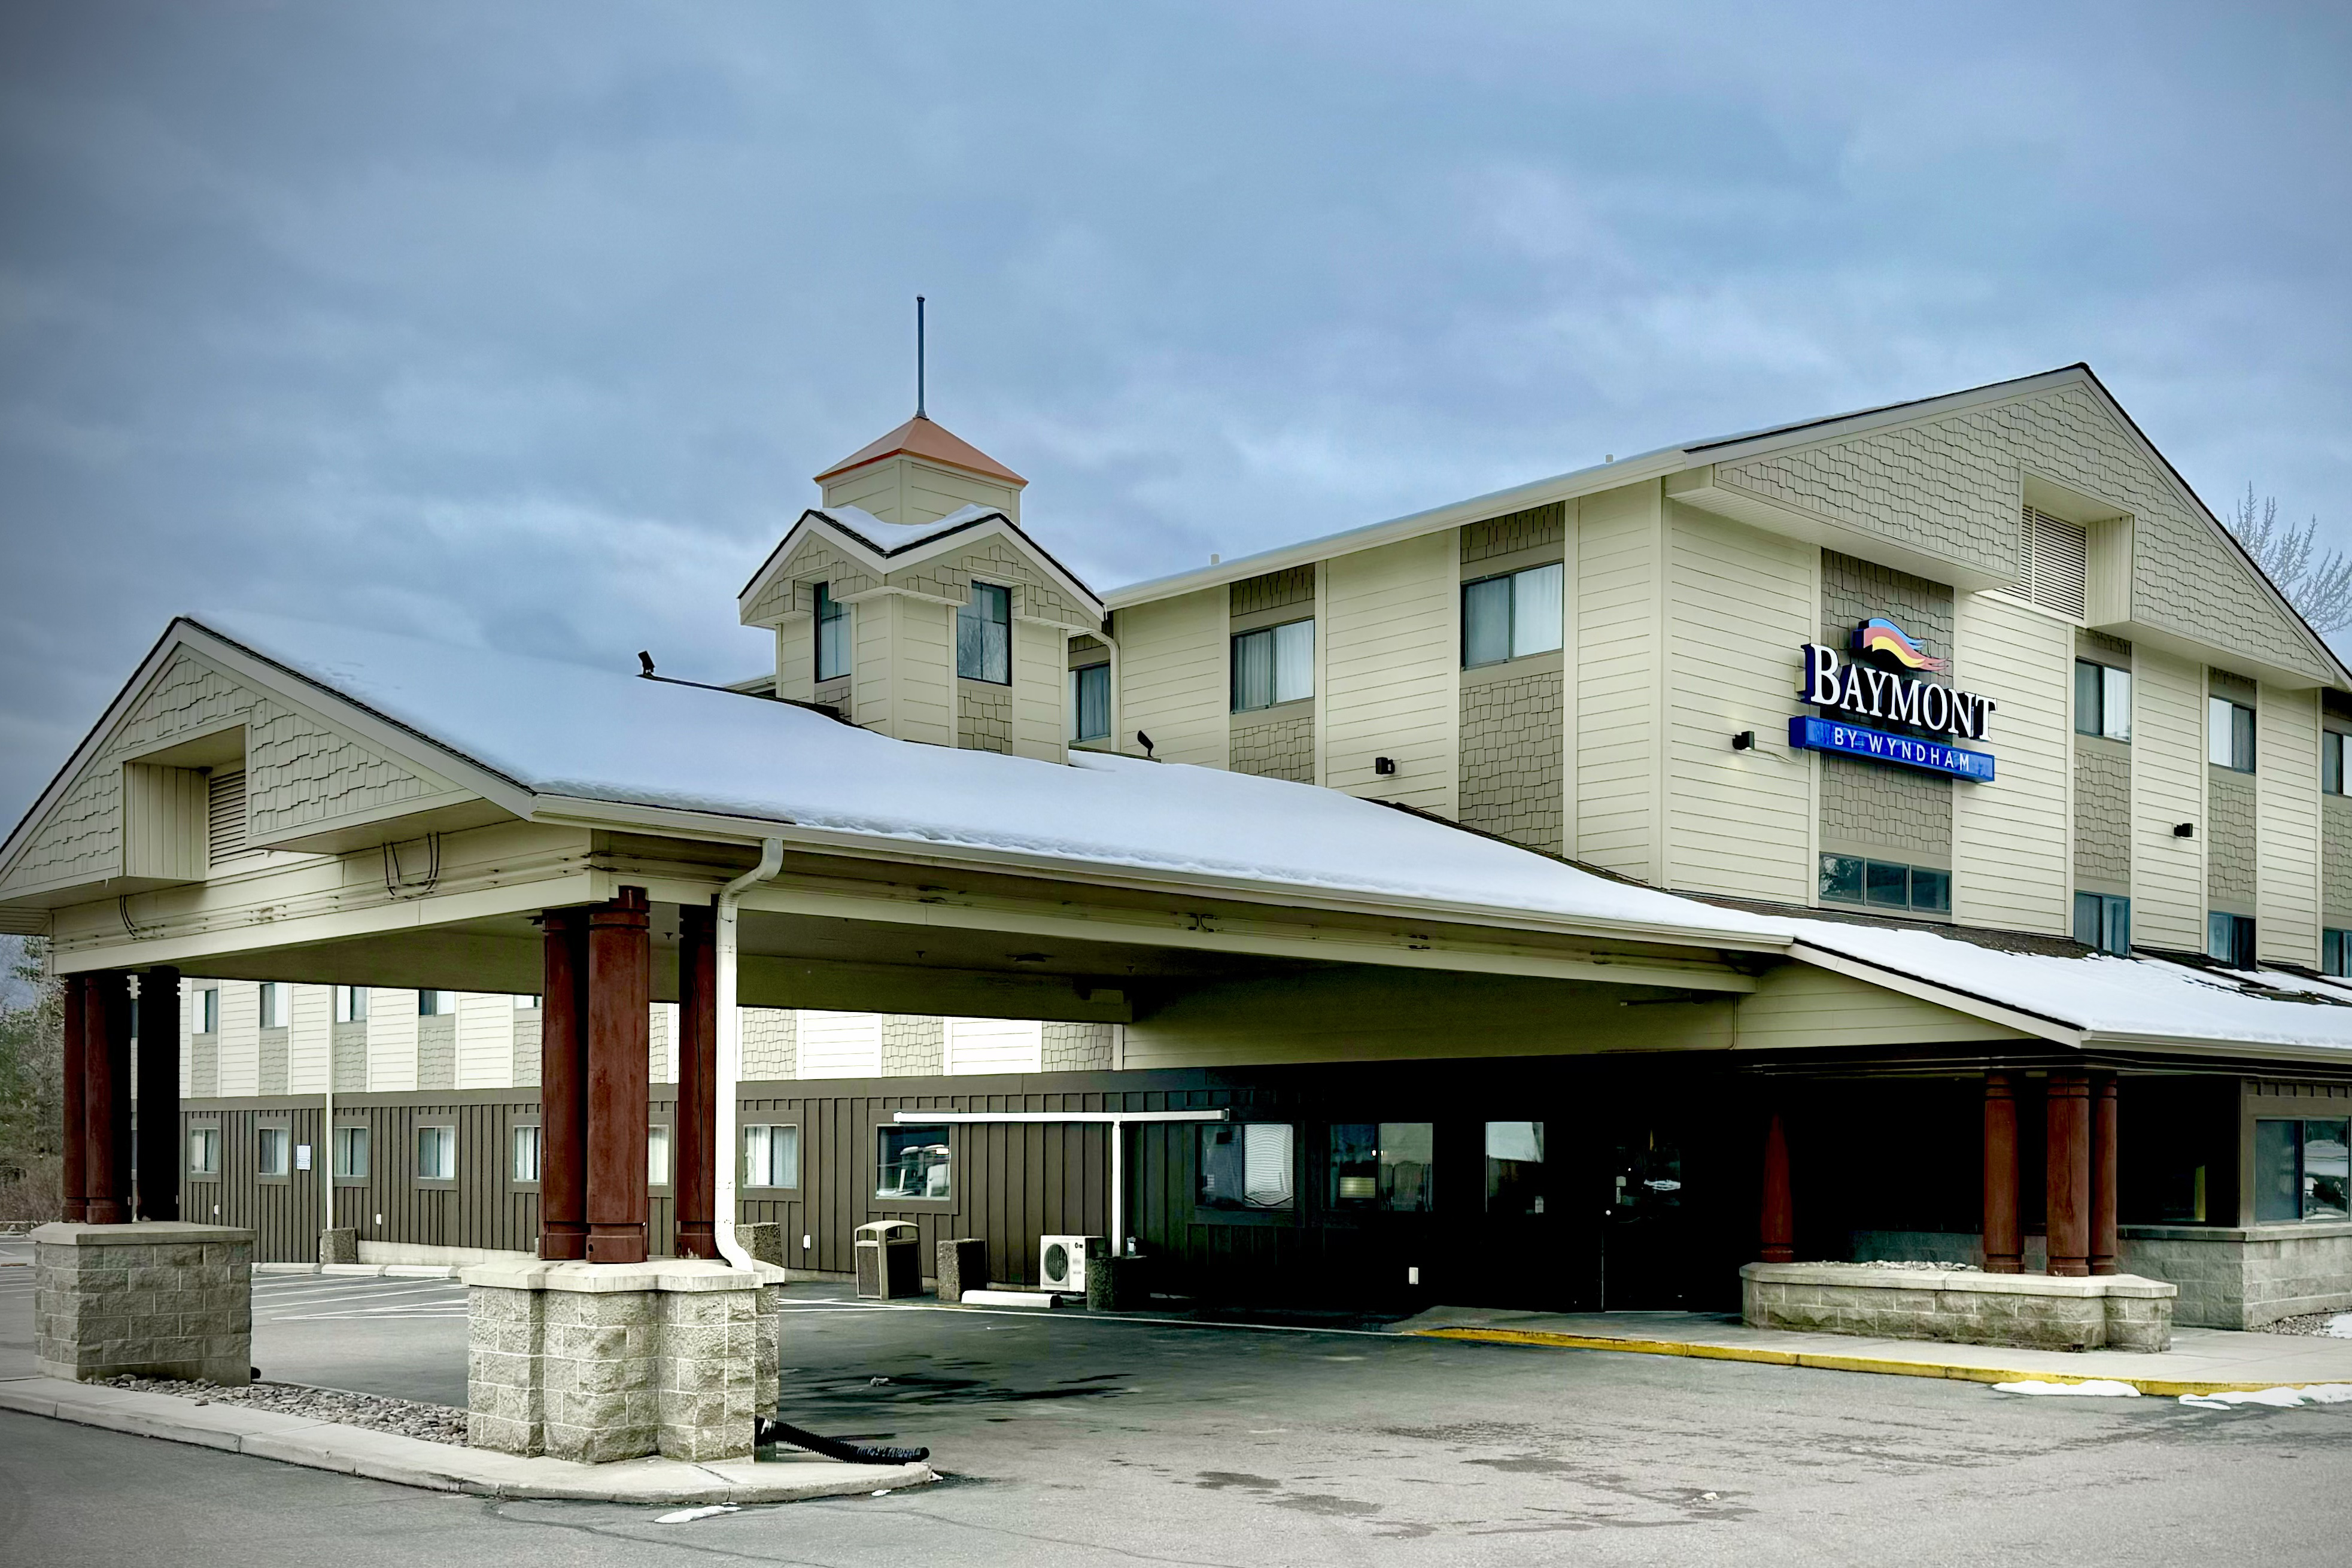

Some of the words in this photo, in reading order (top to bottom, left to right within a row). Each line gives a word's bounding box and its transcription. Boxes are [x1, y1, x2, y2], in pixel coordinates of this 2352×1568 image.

[1809, 643, 1997, 742] BAYMONT
[1834, 727, 1858, 748] BY
[1868, 736, 1970, 771] WYNDHAM
